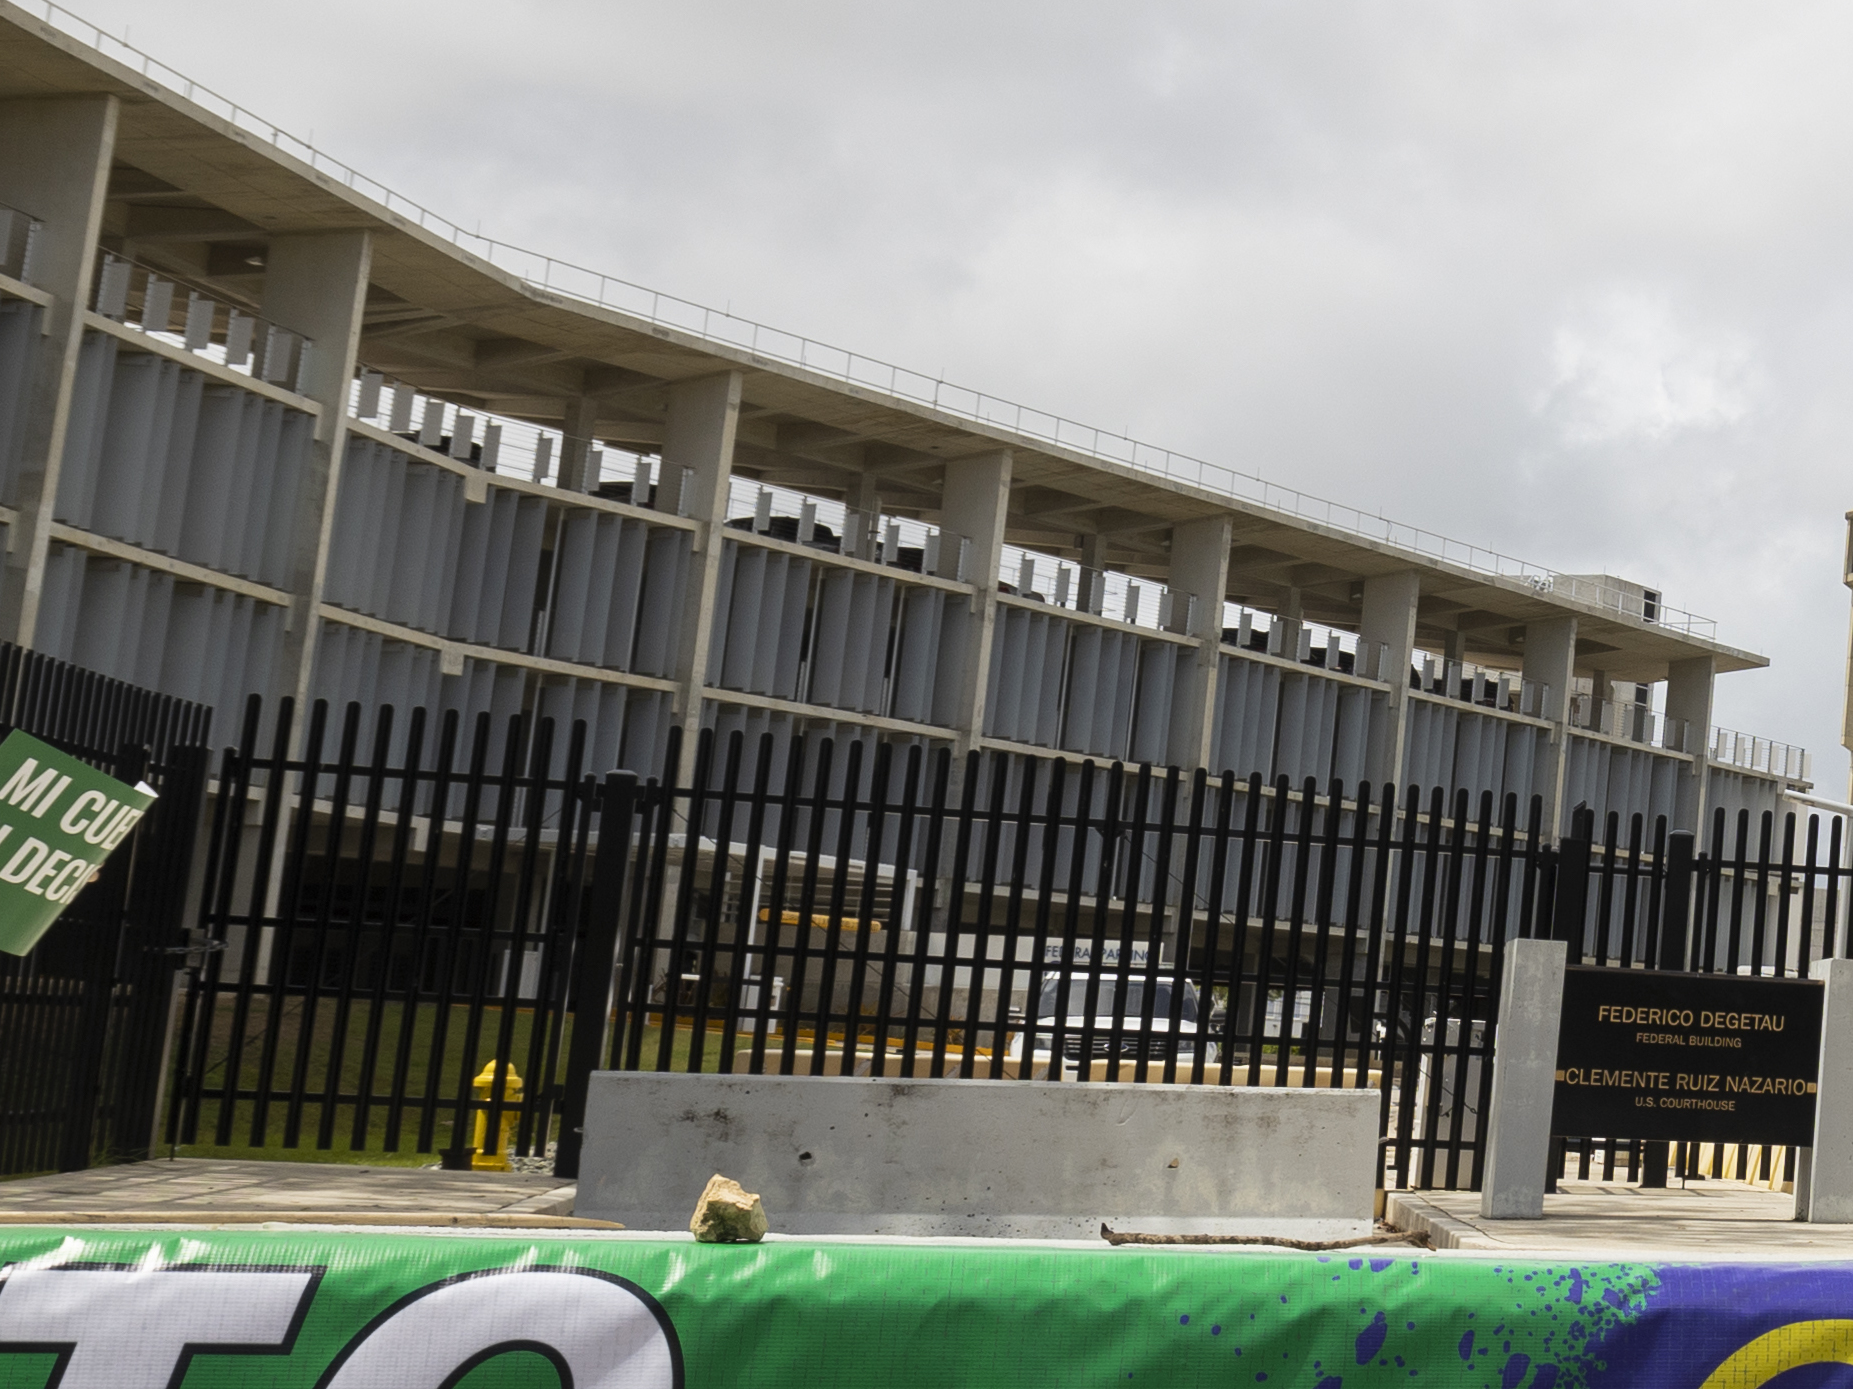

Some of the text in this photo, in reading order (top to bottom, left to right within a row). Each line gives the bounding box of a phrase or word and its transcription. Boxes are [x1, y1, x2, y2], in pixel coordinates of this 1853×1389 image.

[0, 757, 145, 851] MI CUE
[1598, 1005, 1785, 1032] FEDERICO DEGETAU
[1636, 1032, 1742, 1048] FEDERAL BUILDING
[1565, 1067, 1806, 1096] CLEMENTE RUIZ NAZARIO
[1635, 1096, 1736, 1111] U.S. COURTHOUSE
